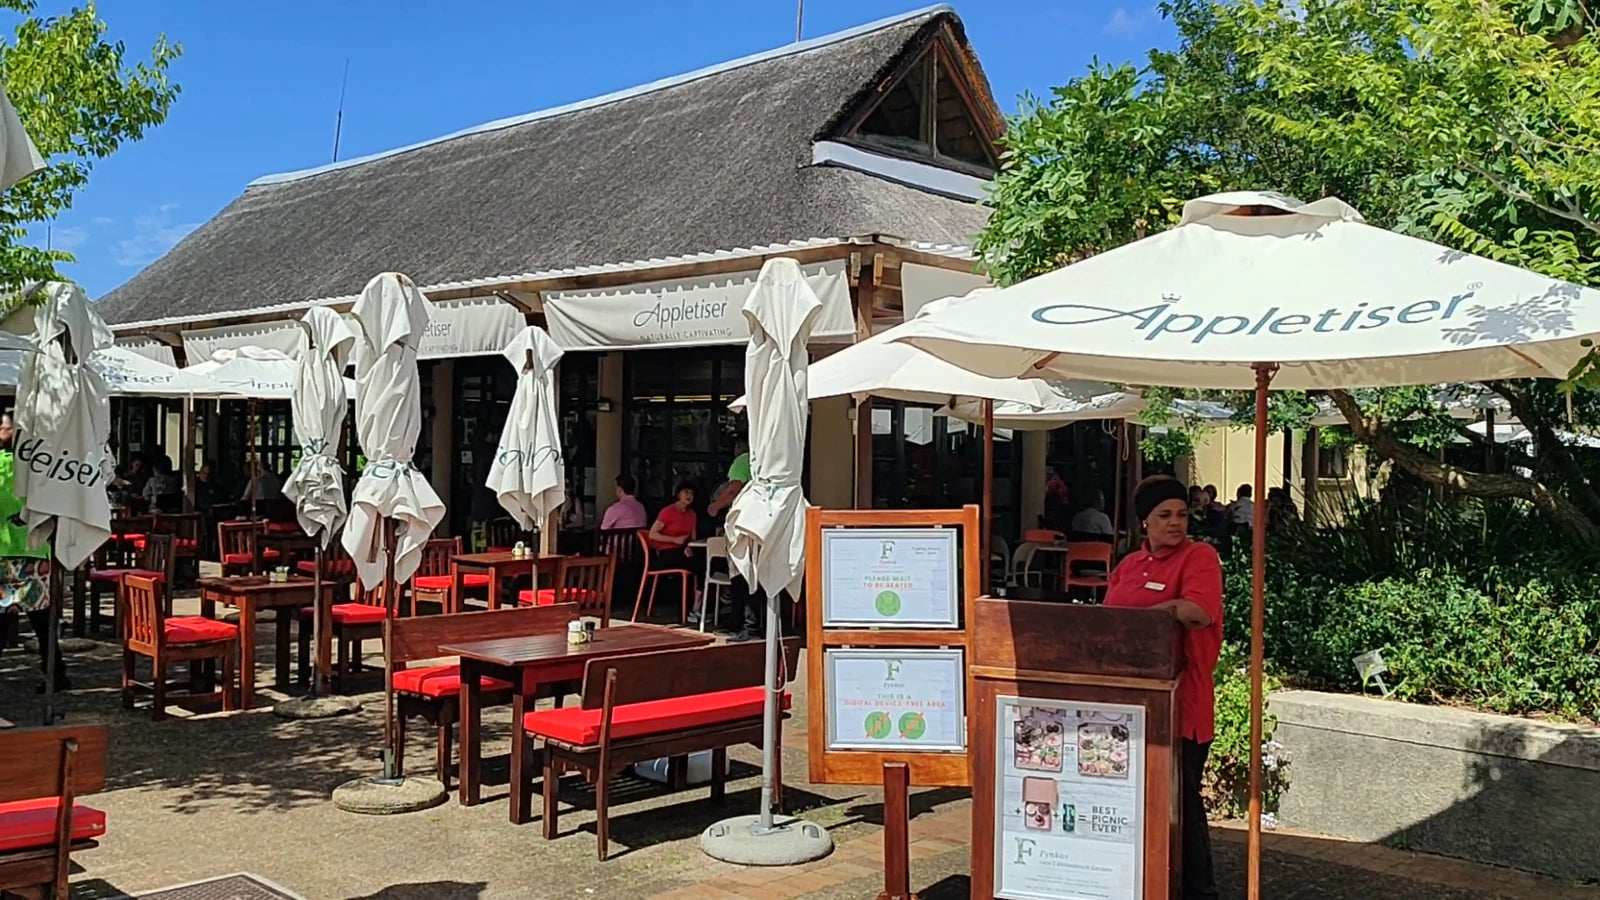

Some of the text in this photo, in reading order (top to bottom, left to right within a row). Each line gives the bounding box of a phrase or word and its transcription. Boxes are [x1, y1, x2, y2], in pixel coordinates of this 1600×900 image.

[632, 298, 728, 329] Appletiser
[1031, 291, 1474, 343] Appletiser
[640, 328, 733, 341] NATURALLY CAPTIVATING
[880, 540, 897, 559] F
[884, 659, 903, 681] F
[1092, 805, 1118, 815] BEST
[1091, 824, 1122, 834] EVER!
[1092, 814, 1128, 826] PICNIC
[1013, 836, 1037, 866] F
